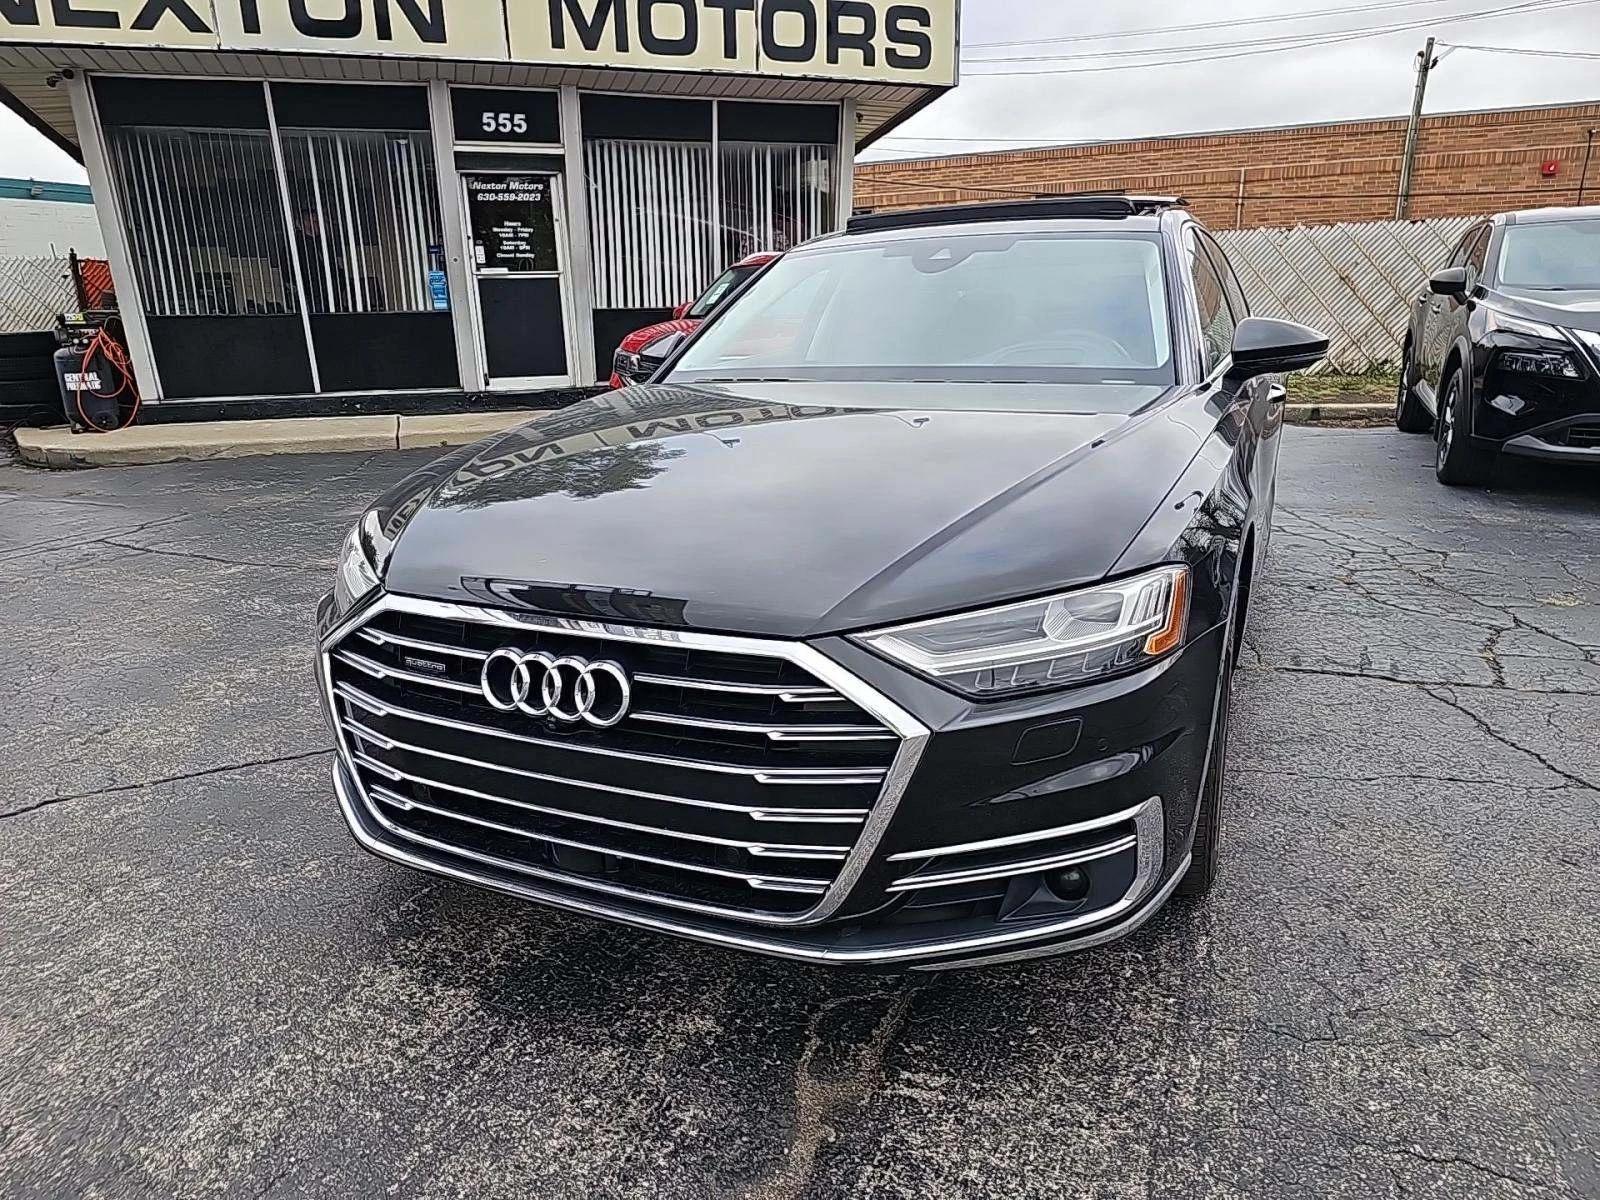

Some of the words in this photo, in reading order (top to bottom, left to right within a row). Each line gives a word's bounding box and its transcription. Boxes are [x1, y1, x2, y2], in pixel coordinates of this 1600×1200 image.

[548, 0, 932, 70] MOTORS
[481, 112, 528, 133] 555
[472, 181, 507, 190] Nexton
[509, 181, 544, 190] Motors
[477, 192, 541, 201] 630-559-2023
